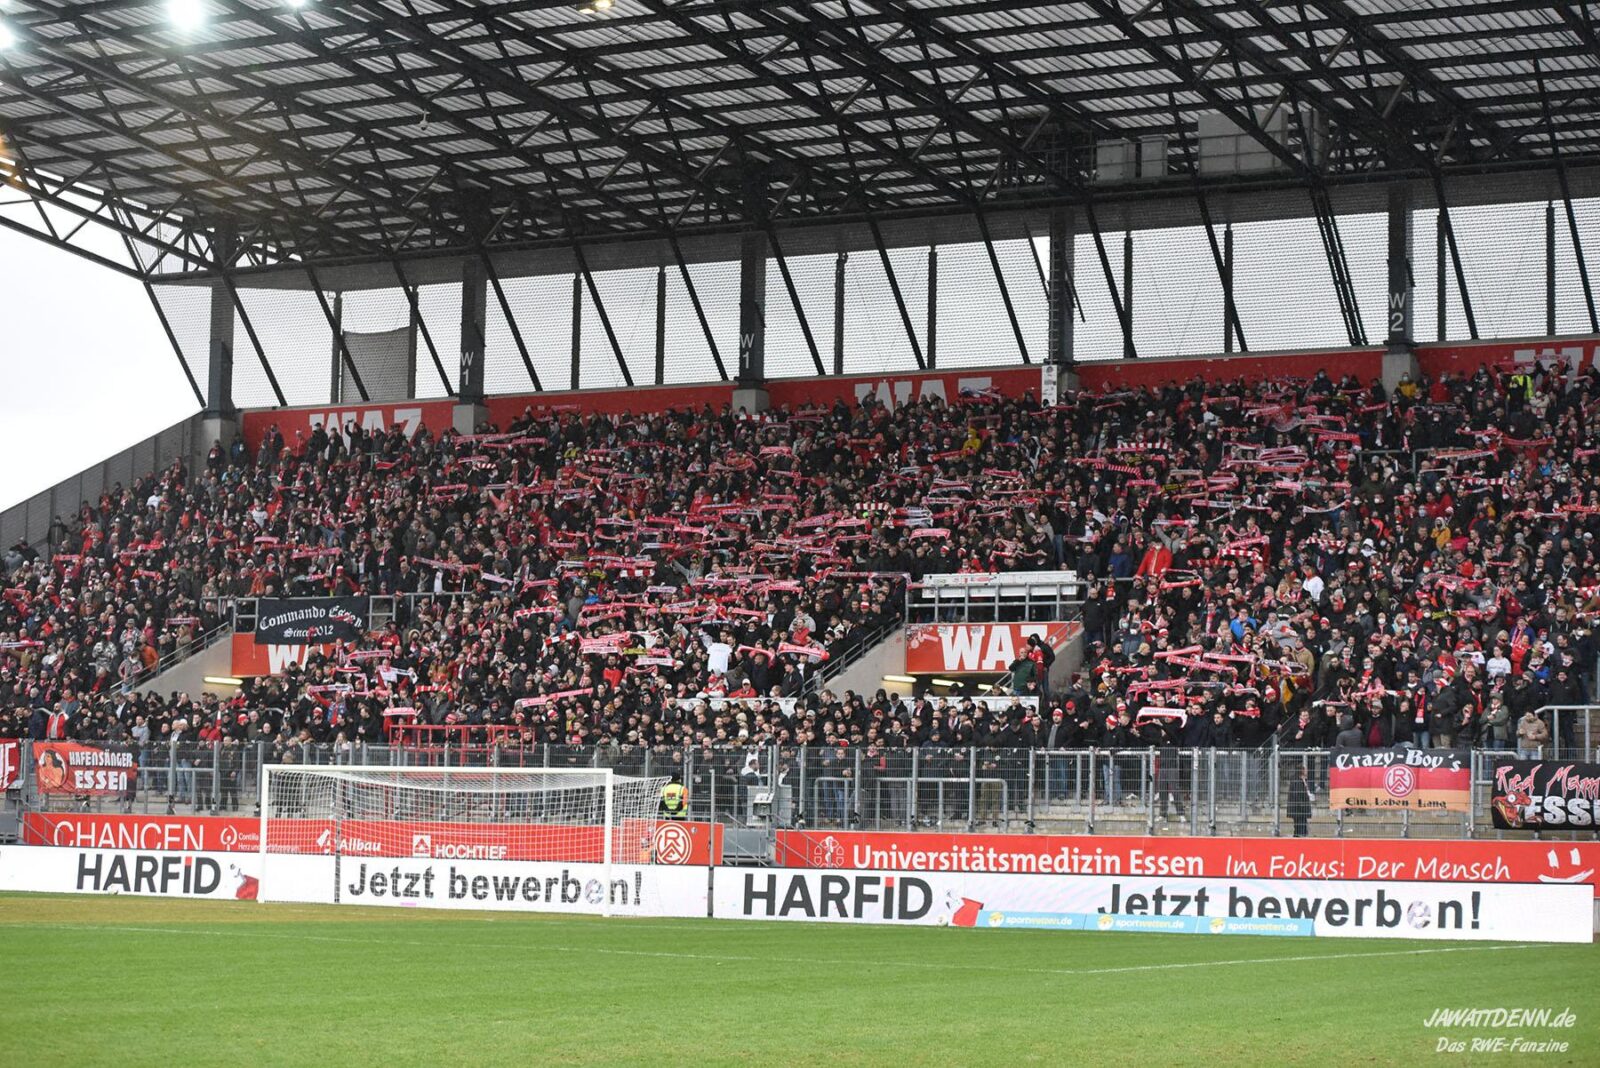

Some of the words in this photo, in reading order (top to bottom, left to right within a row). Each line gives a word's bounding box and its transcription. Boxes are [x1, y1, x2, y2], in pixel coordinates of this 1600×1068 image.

[1390, 312, 1404, 332] 2
[259, 606, 326, 631] Commando
[339, 839, 381, 851] Allbau
[435, 844, 507, 859] HOCHTIEF
[853, 844, 1120, 875] Universitätsmedizin
[1129, 849, 1204, 875] Essen
[1226, 855, 1258, 876] Im
[1269, 853, 1345, 879] Fokus:
[1358, 856, 1405, 879] Der
[1414, 856, 1511, 880] Mensch
[349, 863, 435, 898] Jetzt
[1098, 884, 1209, 917] Jetzt
